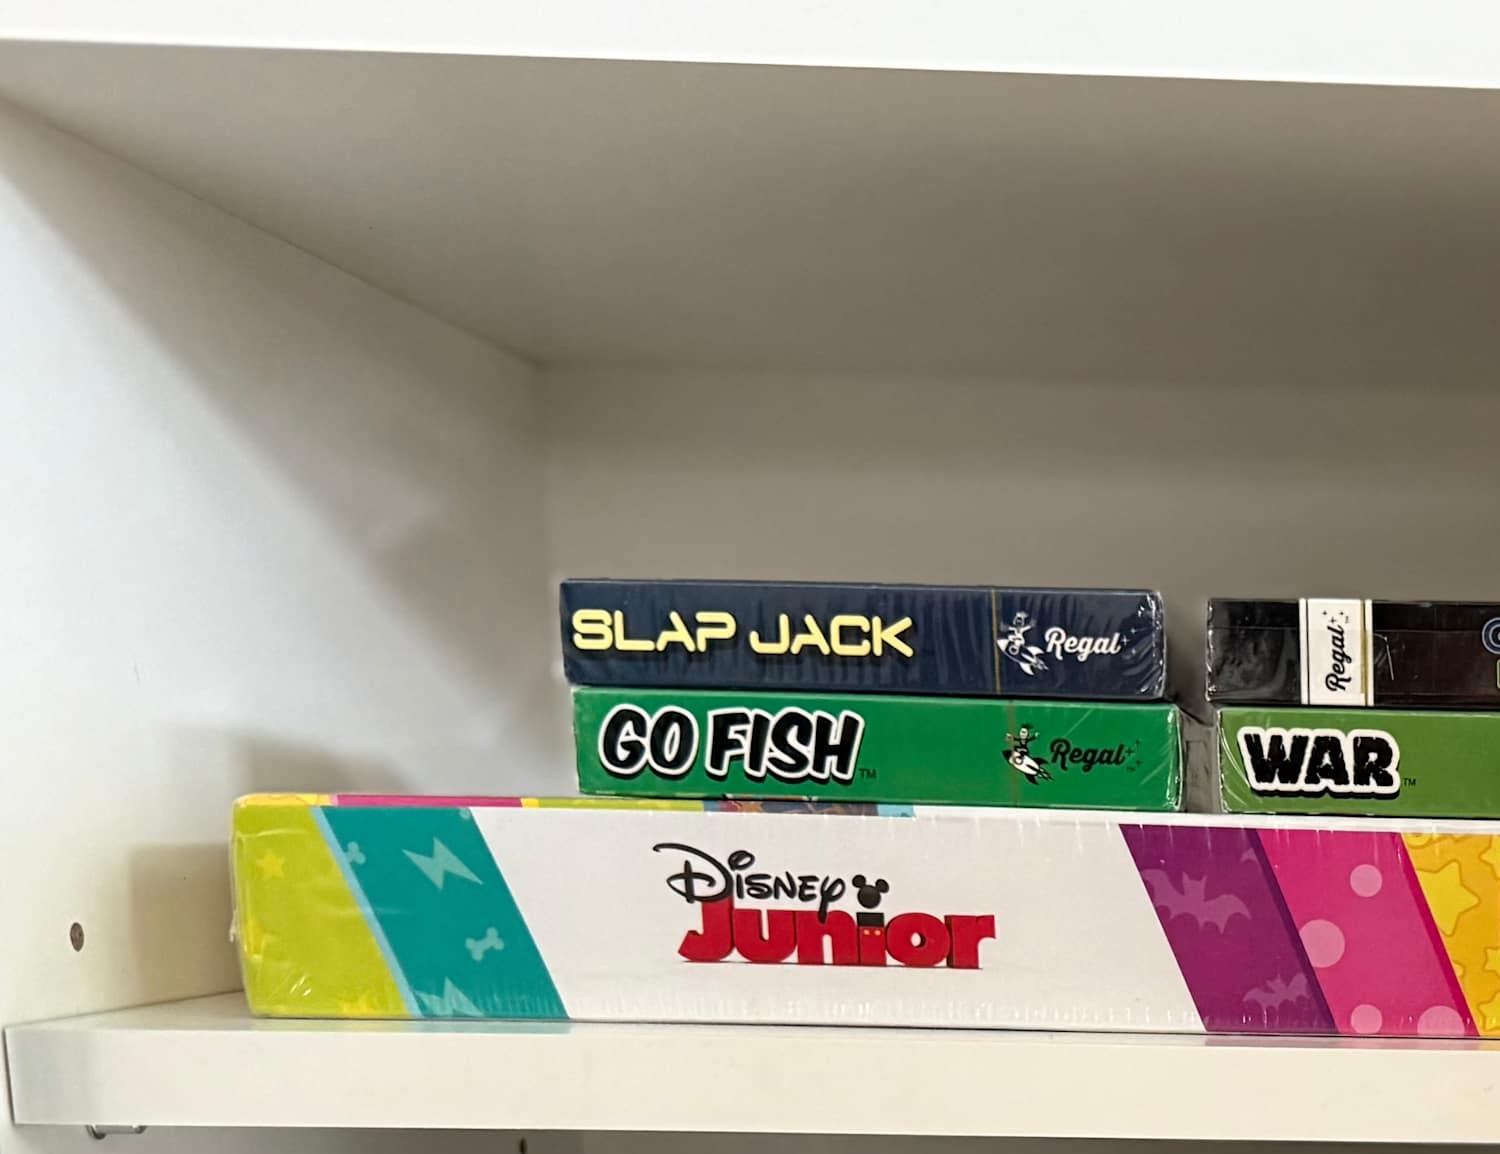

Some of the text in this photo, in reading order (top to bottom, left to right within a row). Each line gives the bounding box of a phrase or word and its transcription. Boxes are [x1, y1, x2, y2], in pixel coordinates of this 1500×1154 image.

[572, 608, 915, 659] SLAP JACK
[1044, 627, 1121, 658] Regal
[1325, 625, 1347, 693] Regal
[598, 703, 699, 778] GO
[704, 705, 867, 785] FISH
[1048, 737, 1126, 770] Regal
[1236, 726, 1401, 797] WAR
[652, 842, 846, 924] Disney
[677, 890, 997, 970] Junior
